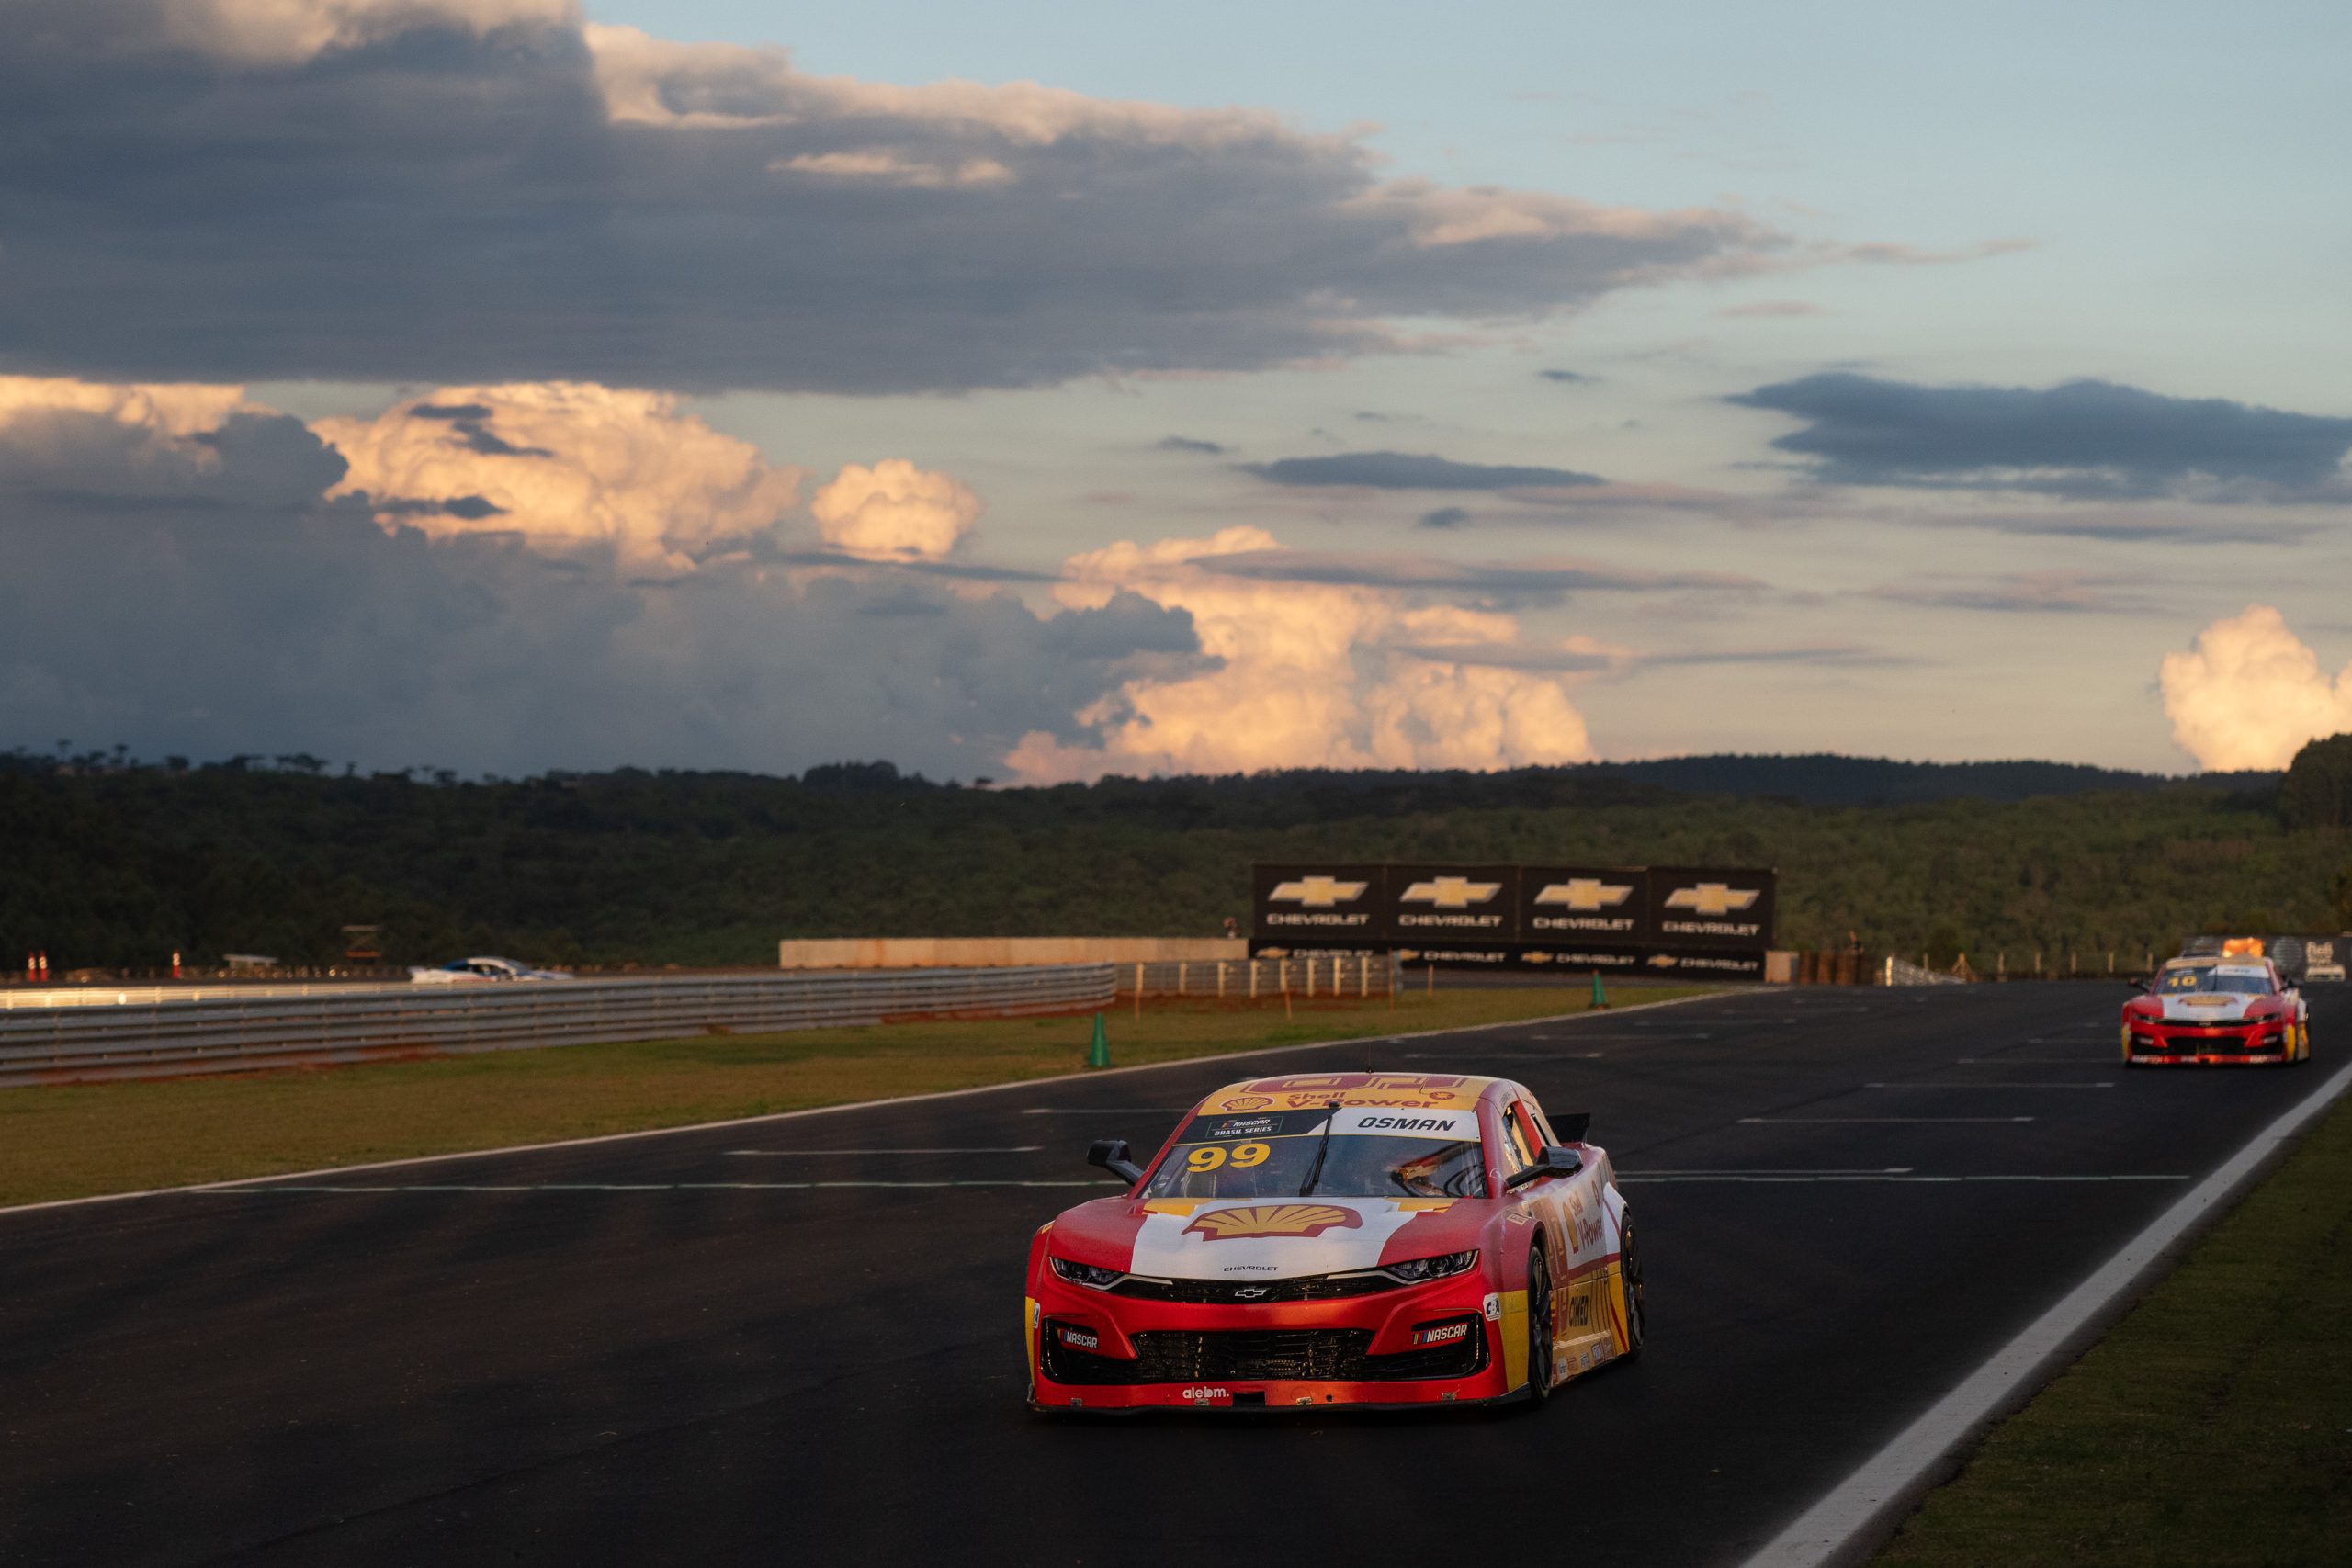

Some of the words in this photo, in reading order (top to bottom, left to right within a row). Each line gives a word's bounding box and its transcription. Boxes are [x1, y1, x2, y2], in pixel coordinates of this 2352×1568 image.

[1266, 913, 1370, 926] CHEVROLET
[1398, 914, 1504, 927] CHEVROLET
[1532, 917, 1634, 931] CHEVROLET
[1662, 920, 1761, 936] CHEVROLET
[1424, 950, 1507, 963] CHEVROLET
[1556, 953, 1636, 965] CHEVROLET
[1680, 956, 1759, 970] CHEVROLET
[1288, 1091, 1346, 1100] Shell
[1287, 1098, 1439, 1109] V-Power
[1233, 1119, 1271, 1127] NASCAR
[1357, 1116, 1457, 1132] OSMAN
[1186, 1143, 1271, 1173] 99
[1066, 1331, 1098, 1348] NASCAR
[1426, 1324, 1468, 1343] NASCAR
